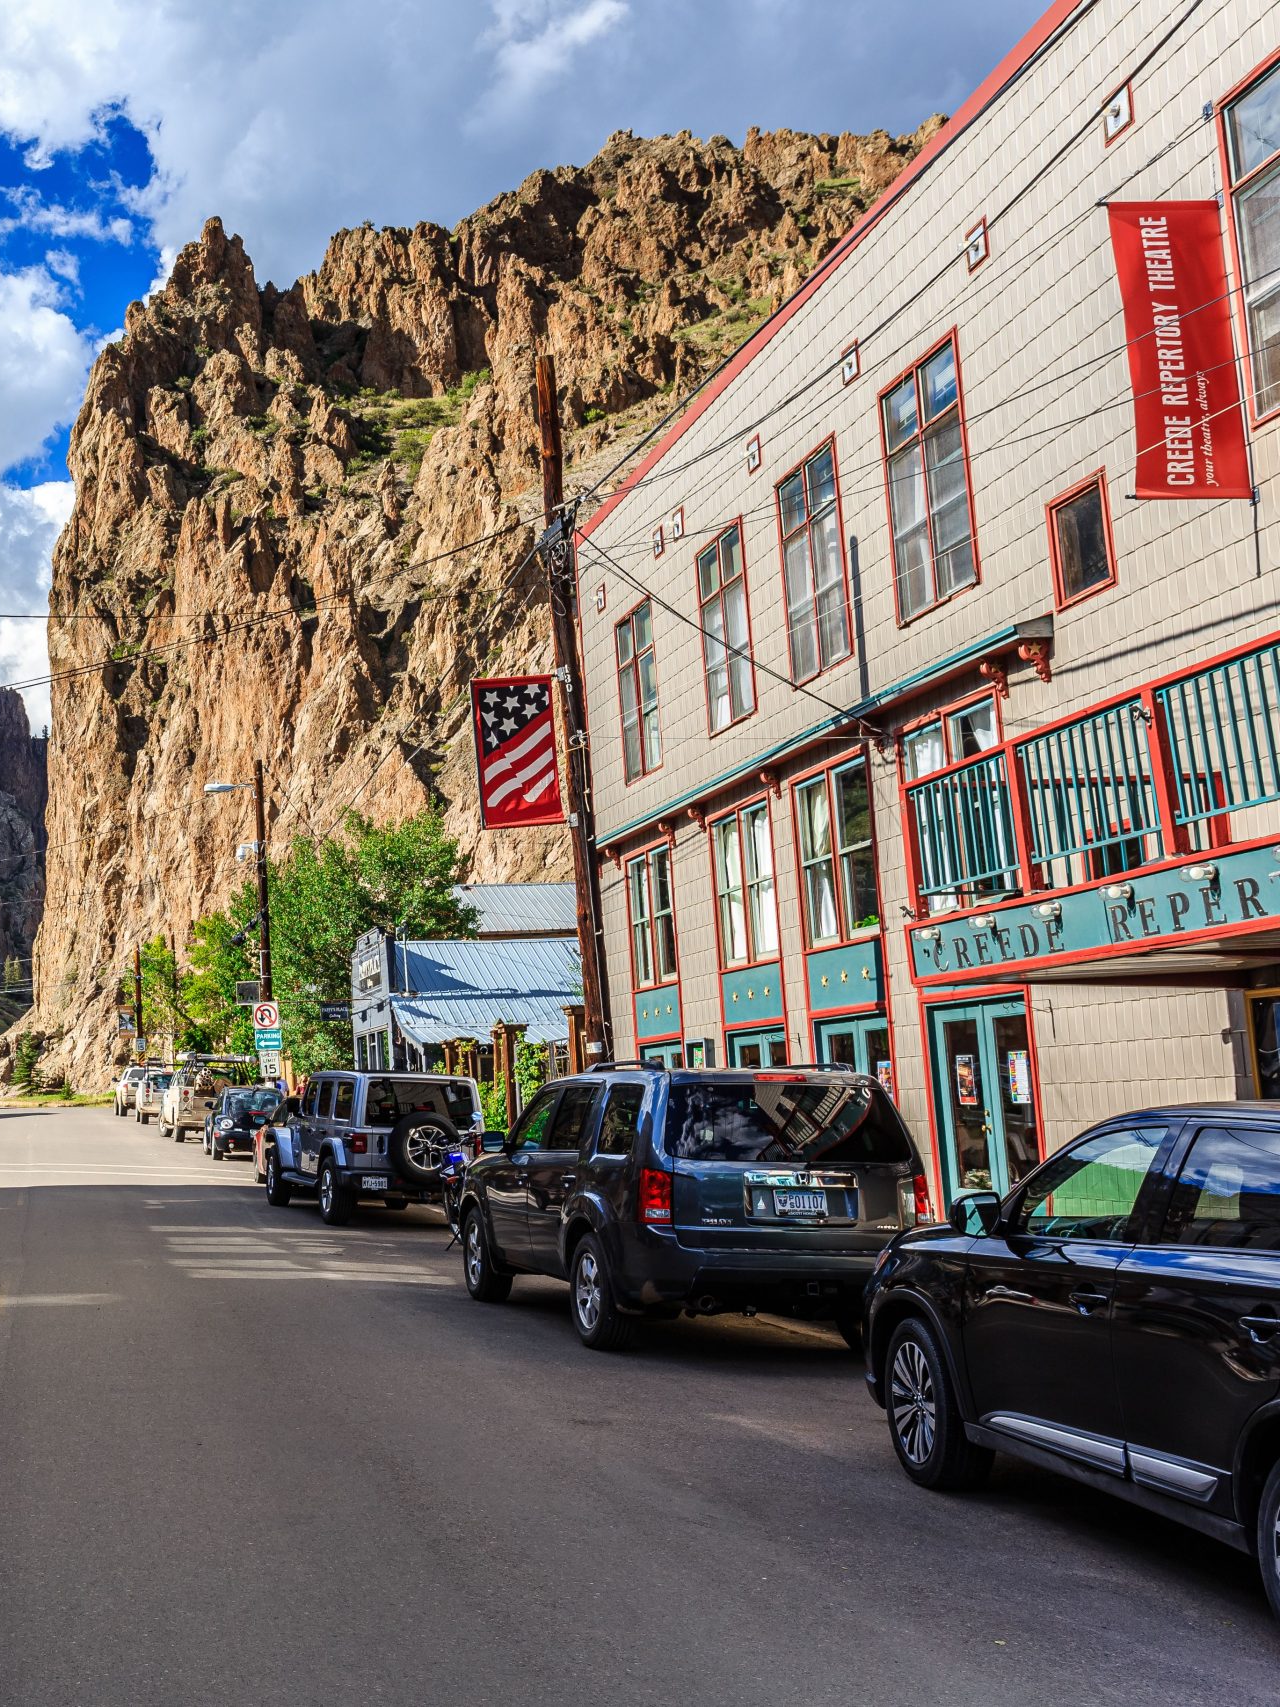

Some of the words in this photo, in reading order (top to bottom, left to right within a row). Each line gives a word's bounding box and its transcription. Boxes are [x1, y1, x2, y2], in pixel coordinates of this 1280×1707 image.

[1139, 216, 1176, 292] THEATRE
[1151, 301, 1189, 406] REPERTORY
[1195, 370, 1210, 411] always
[1164, 415, 1195, 486] CREEDE
[1204, 459, 1220, 487] your
[931, 918, 1066, 972] CREEDE
[1108, 870, 1280, 943] REPER
[264, 1064, 277, 1075] 15
[795, 1195, 825, 1209] 01107
